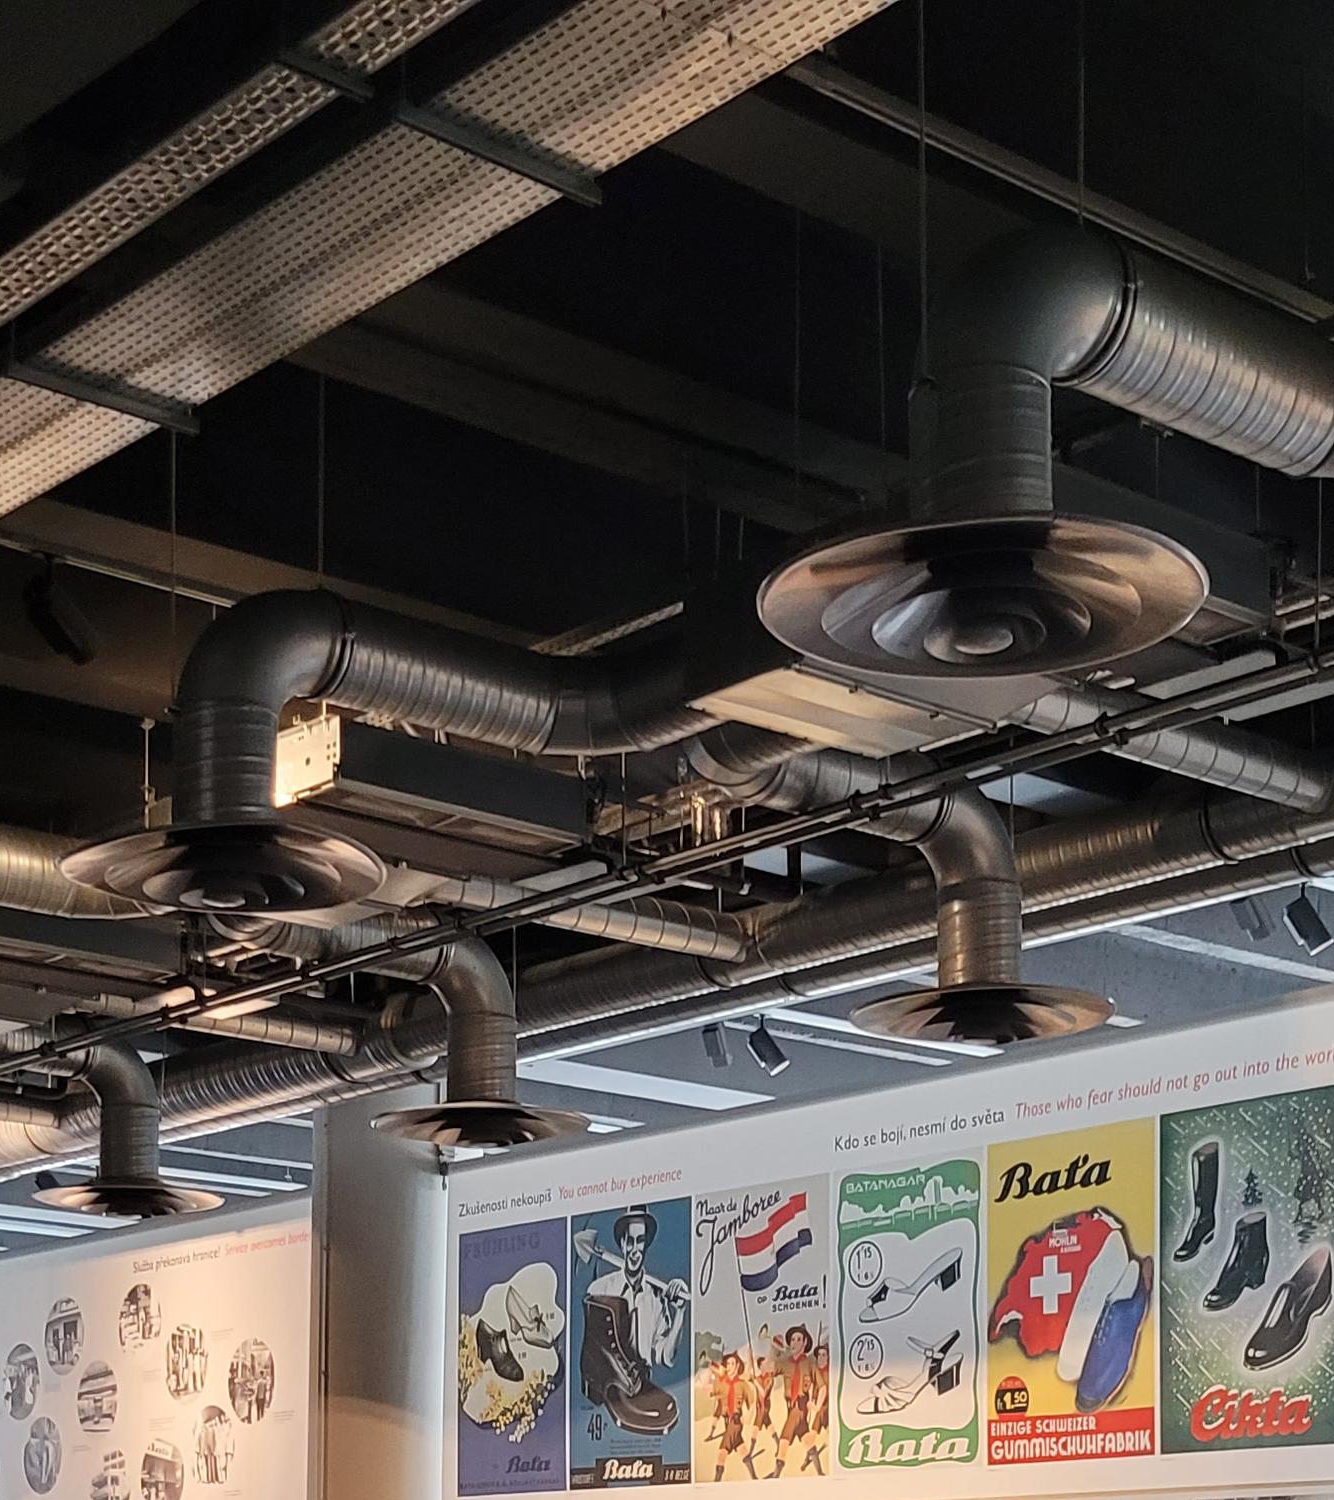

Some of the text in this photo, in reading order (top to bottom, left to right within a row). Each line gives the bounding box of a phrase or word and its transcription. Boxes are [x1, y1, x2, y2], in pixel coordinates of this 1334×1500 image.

[834, 1135, 860, 1152] Kdo
[863, 1134, 876, 1147] se
[909, 1116, 947, 1139] nesmí
[950, 1114, 968, 1131] do
[971, 1108, 1005, 1128] světa
[1015, 1101, 1052, 1120] Those
[1056, 1094, 1083, 1111] who
[1087, 1087, 1114, 1111] fear
[1117, 1076, 1162, 1101] should
[1166, 1074, 1189, 1093] not
[1193, 1072, 1210, 1092] go
[1215, 1065, 1238, 1083] out
[1242, 1060, 1270, 1078] into
[1275, 1052, 1300, 1071] the
[458, 1196, 509, 1218] Zkušenosti
[558, 1185, 575, 1200] You
[576, 1180, 608, 1198] cannot
[611, 1175, 627, 1192] buy
[630, 1168, 682, 1188] experience
[846, 1174, 926, 1194] BATANAGAR
[994, 1153, 1112, 1203] Baťa
[695, 1190, 782, 1297] Jamboree
[771, 1300, 820, 1313] SCHOENEN
[990, 1415, 1097, 1437] EINZIGE SCHWEIZER
[990, 1429, 1152, 1462] GUMMISCHUHFABRIK
